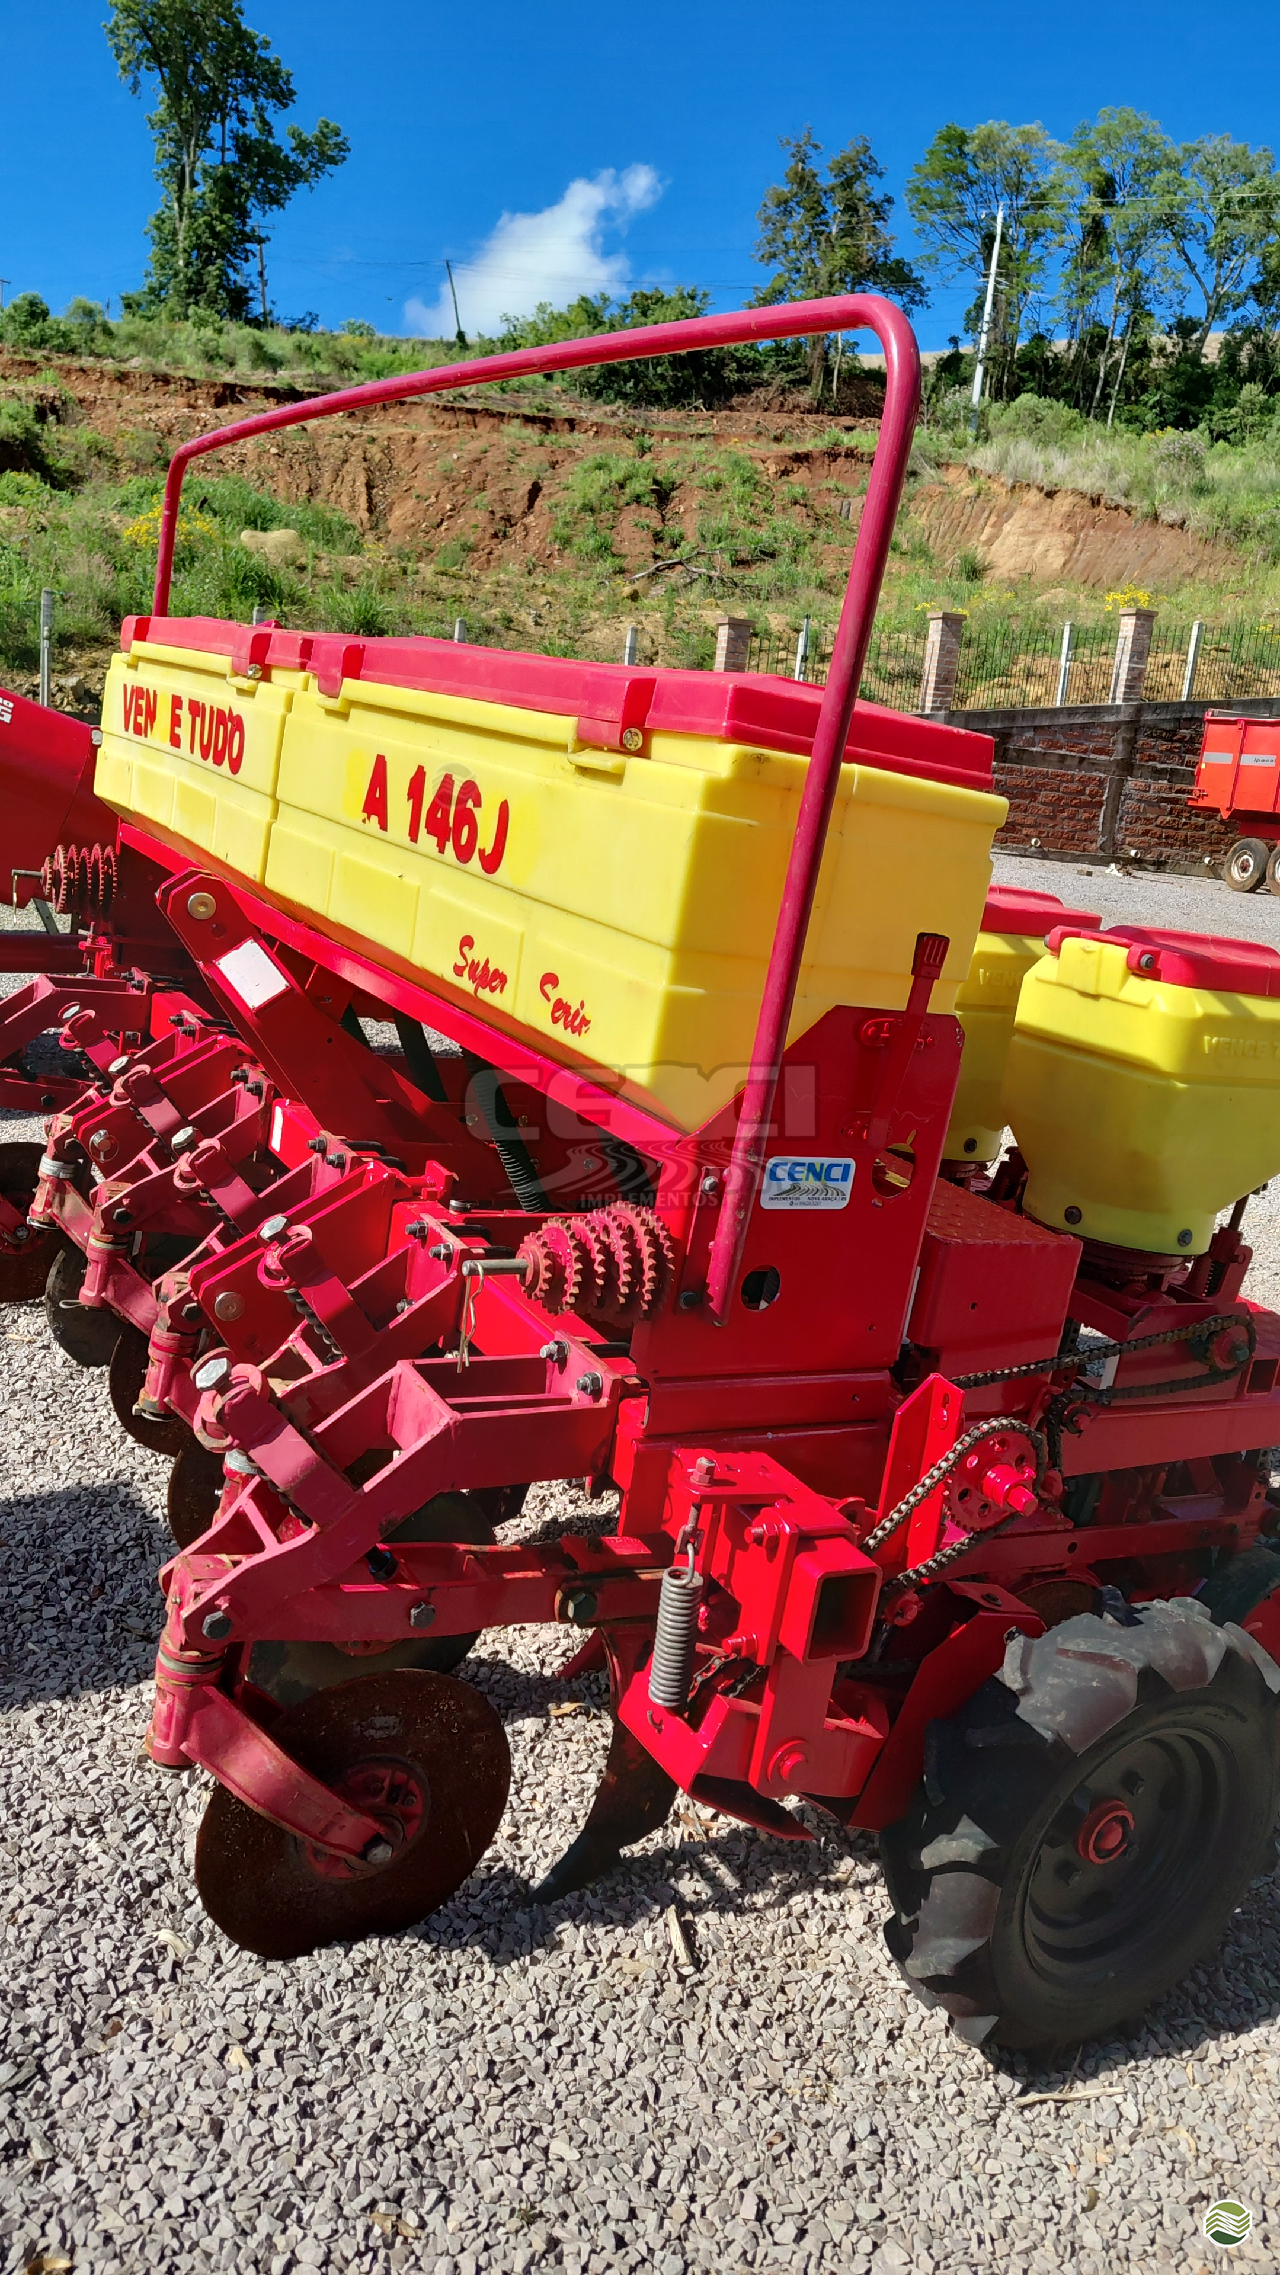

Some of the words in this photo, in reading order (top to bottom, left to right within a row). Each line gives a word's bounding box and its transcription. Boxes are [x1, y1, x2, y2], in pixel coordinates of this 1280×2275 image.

[188, 698, 245, 775] TUDO
[362, 754, 388, 832] A
[453, 934, 508, 996] Super
[769, 1162, 852, 1182] CENCI
